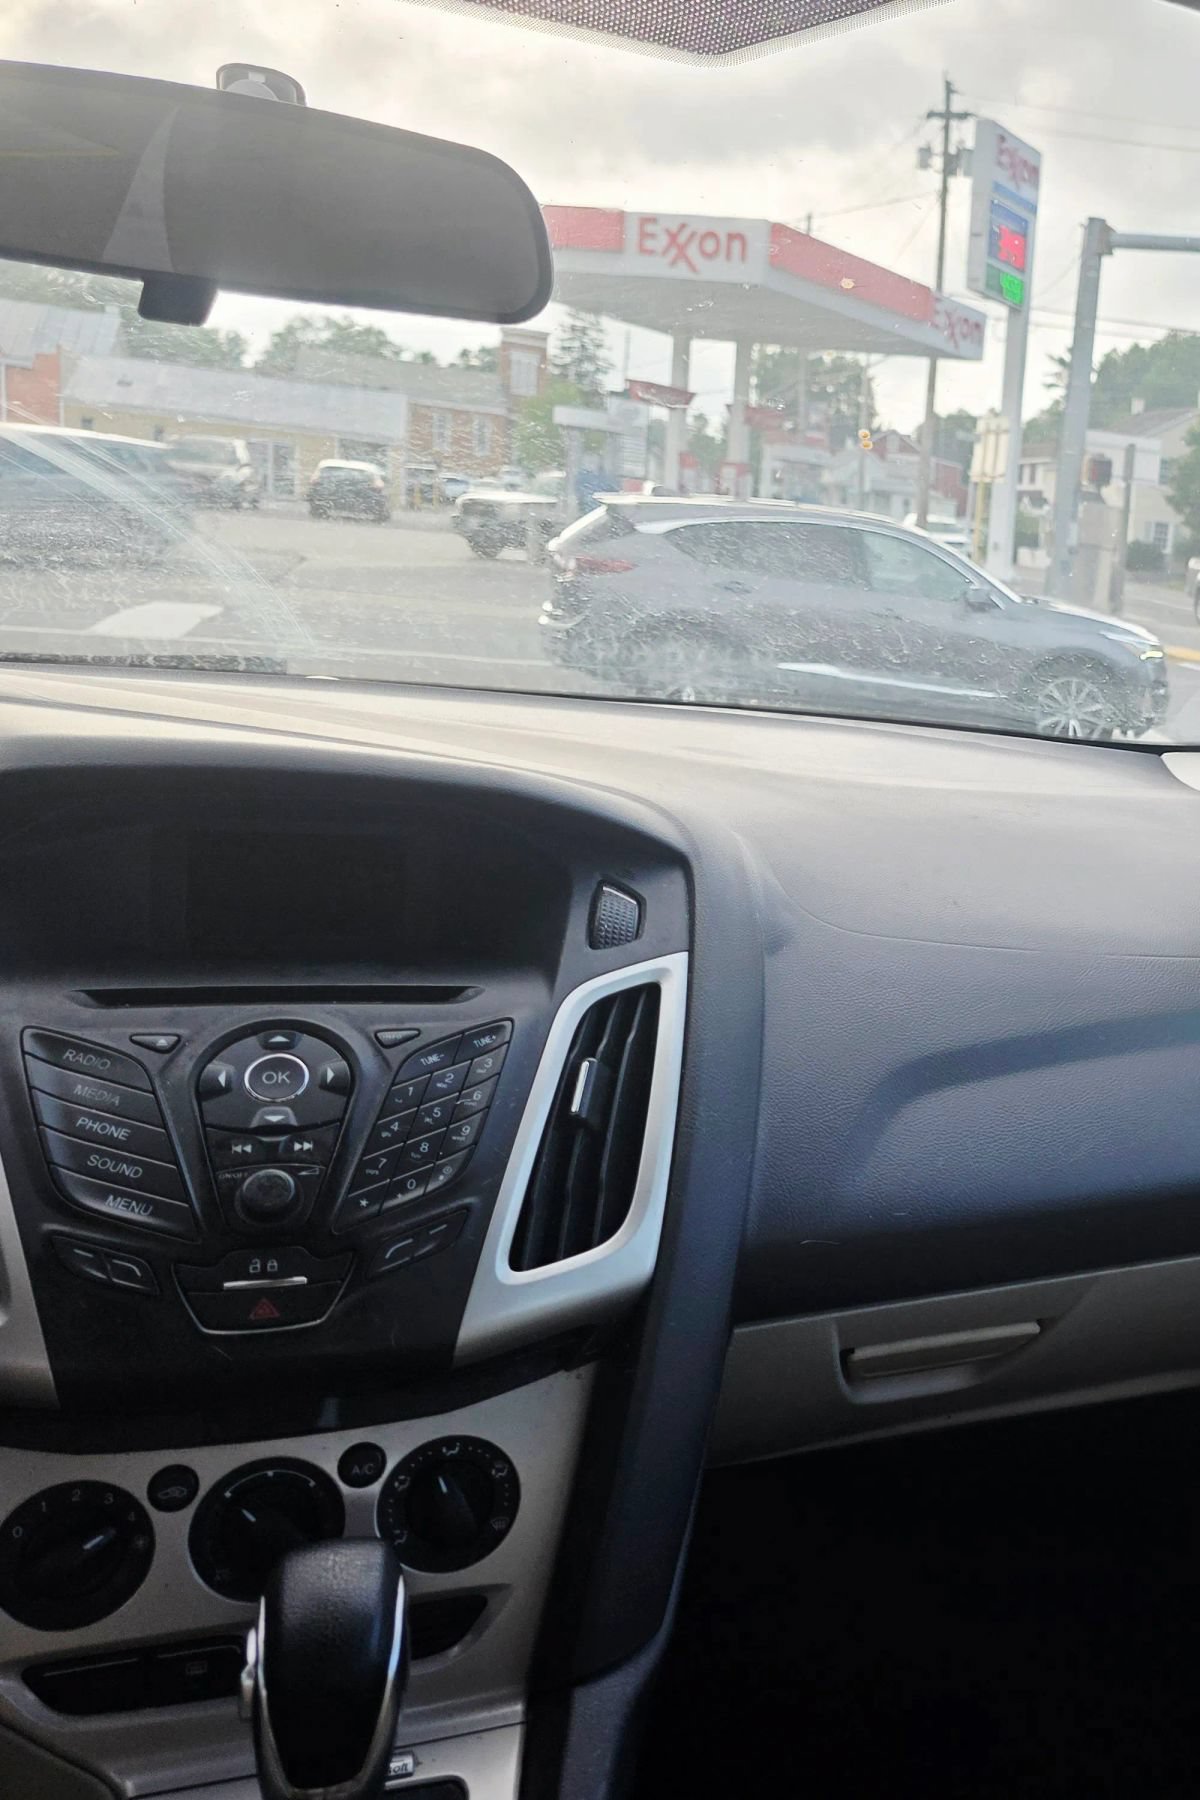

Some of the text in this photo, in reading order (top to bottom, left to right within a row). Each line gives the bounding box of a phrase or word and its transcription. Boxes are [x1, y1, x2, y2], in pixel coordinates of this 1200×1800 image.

[637, 216, 749, 274] Exxon
[63, 1049, 111, 1070] RADIO
[484, 1058, 493, 1068] 3
[261, 1071, 291, 1084] OK
[445, 1073, 454, 1083] 2
[74, 1084, 120, 1107] MEDIA
[408, 1087, 414, 1096] 1
[473, 1090, 482, 1100] 6
[432, 1107, 441, 1117] 5
[76, 1116, 131, 1141] PHONE
[390, 1122, 399, 1131] 4
[461, 1125, 470, 1136] 9
[420, 1142, 429, 1152] 8
[87, 1154, 143, 1179] SOUND
[378, 1157, 387, 1169] 7
[407, 1179, 416, 1190] 0
[105, 1195, 153, 1216] MENU
[72, 1489, 81, 1502] 2
[104, 1492, 114, 1504] 3
[41, 1501, 47, 1512] 1
[12, 1526, 23, 1538] 0
